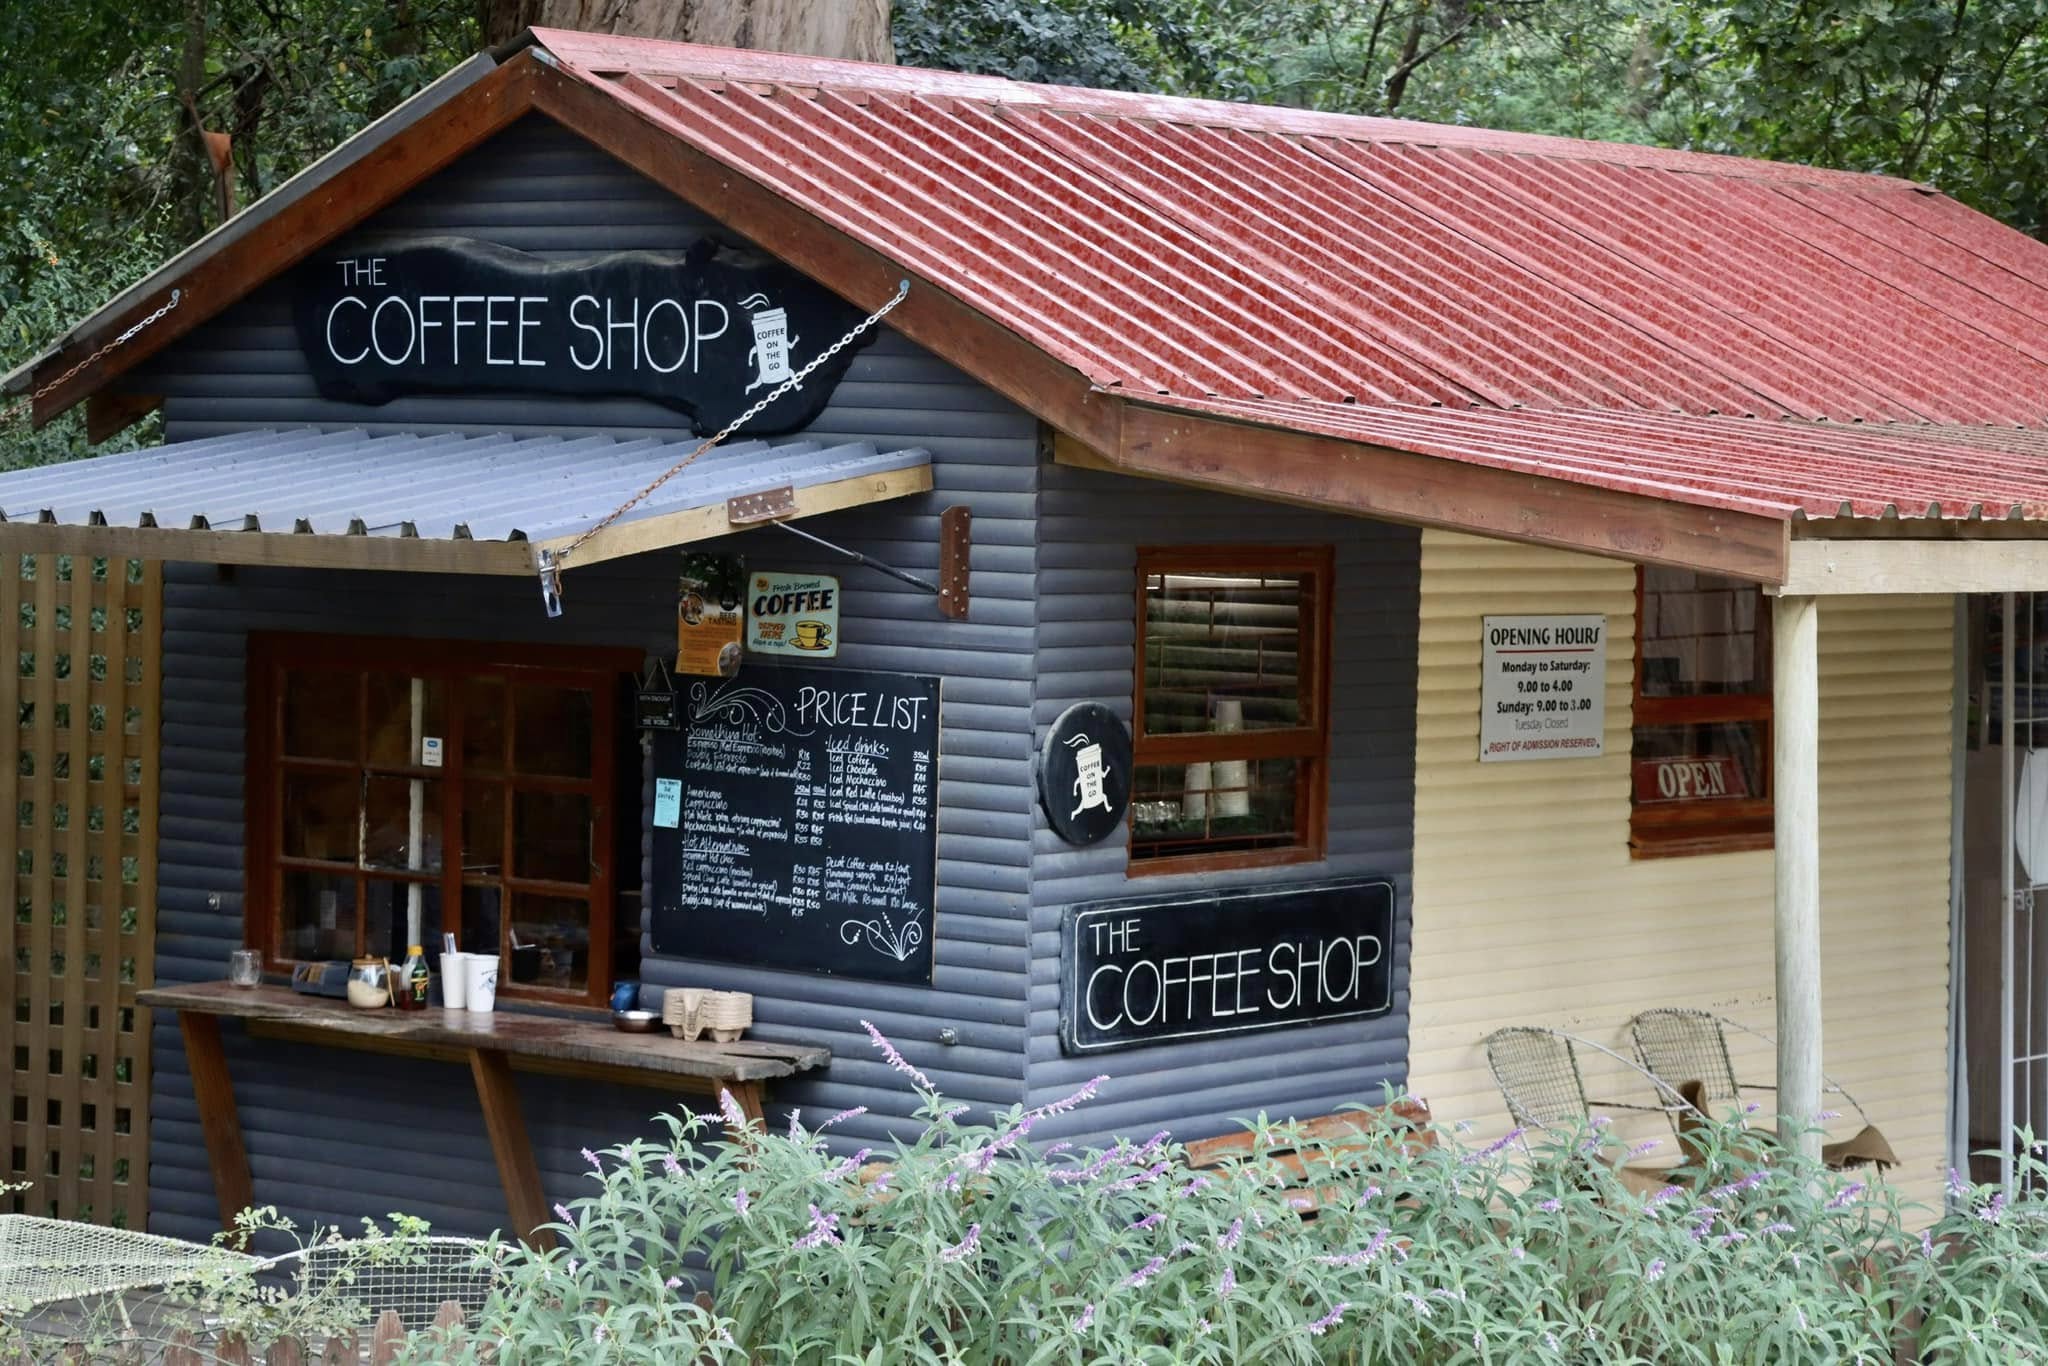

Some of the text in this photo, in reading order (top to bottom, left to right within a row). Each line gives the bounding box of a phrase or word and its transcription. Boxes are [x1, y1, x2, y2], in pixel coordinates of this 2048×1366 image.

[336, 257, 388, 287] THE
[326, 294, 730, 375] COFFEE SHOP
[756, 328, 784, 340] COFFEE
[766, 341, 778, 349] ON
[766, 350, 781, 360] THE
[768, 362, 780, 371] GO
[752, 589, 834, 618] COFFEE
[708, 617, 737, 626] TASTING
[1490, 627, 1600, 646] OPENING HOURS
[1502, 660, 1590, 675] Monday to Saturday:
[1517, 680, 1573, 693] 9.00 to 4.00
[796, 686, 929, 733] PRICE LIST
[1496, 698, 1592, 716] Sunday: 9.00 to 3.00
[1514, 718, 1568, 732] Tuesday Closed
[828, 734, 886, 756] Iced drinks
[1488, 738, 1597, 752] RIGHT OF ADMISSION RESERVED
[848, 753, 870, 766] Coffee
[1080, 760, 1100, 772] COFFEE
[1657, 761, 1727, 798] OPEN
[1088, 790, 1096, 798] GO
[1088, 918, 1141, 956] THE
[1086, 934, 1382, 1030] COFFEE SHOP
